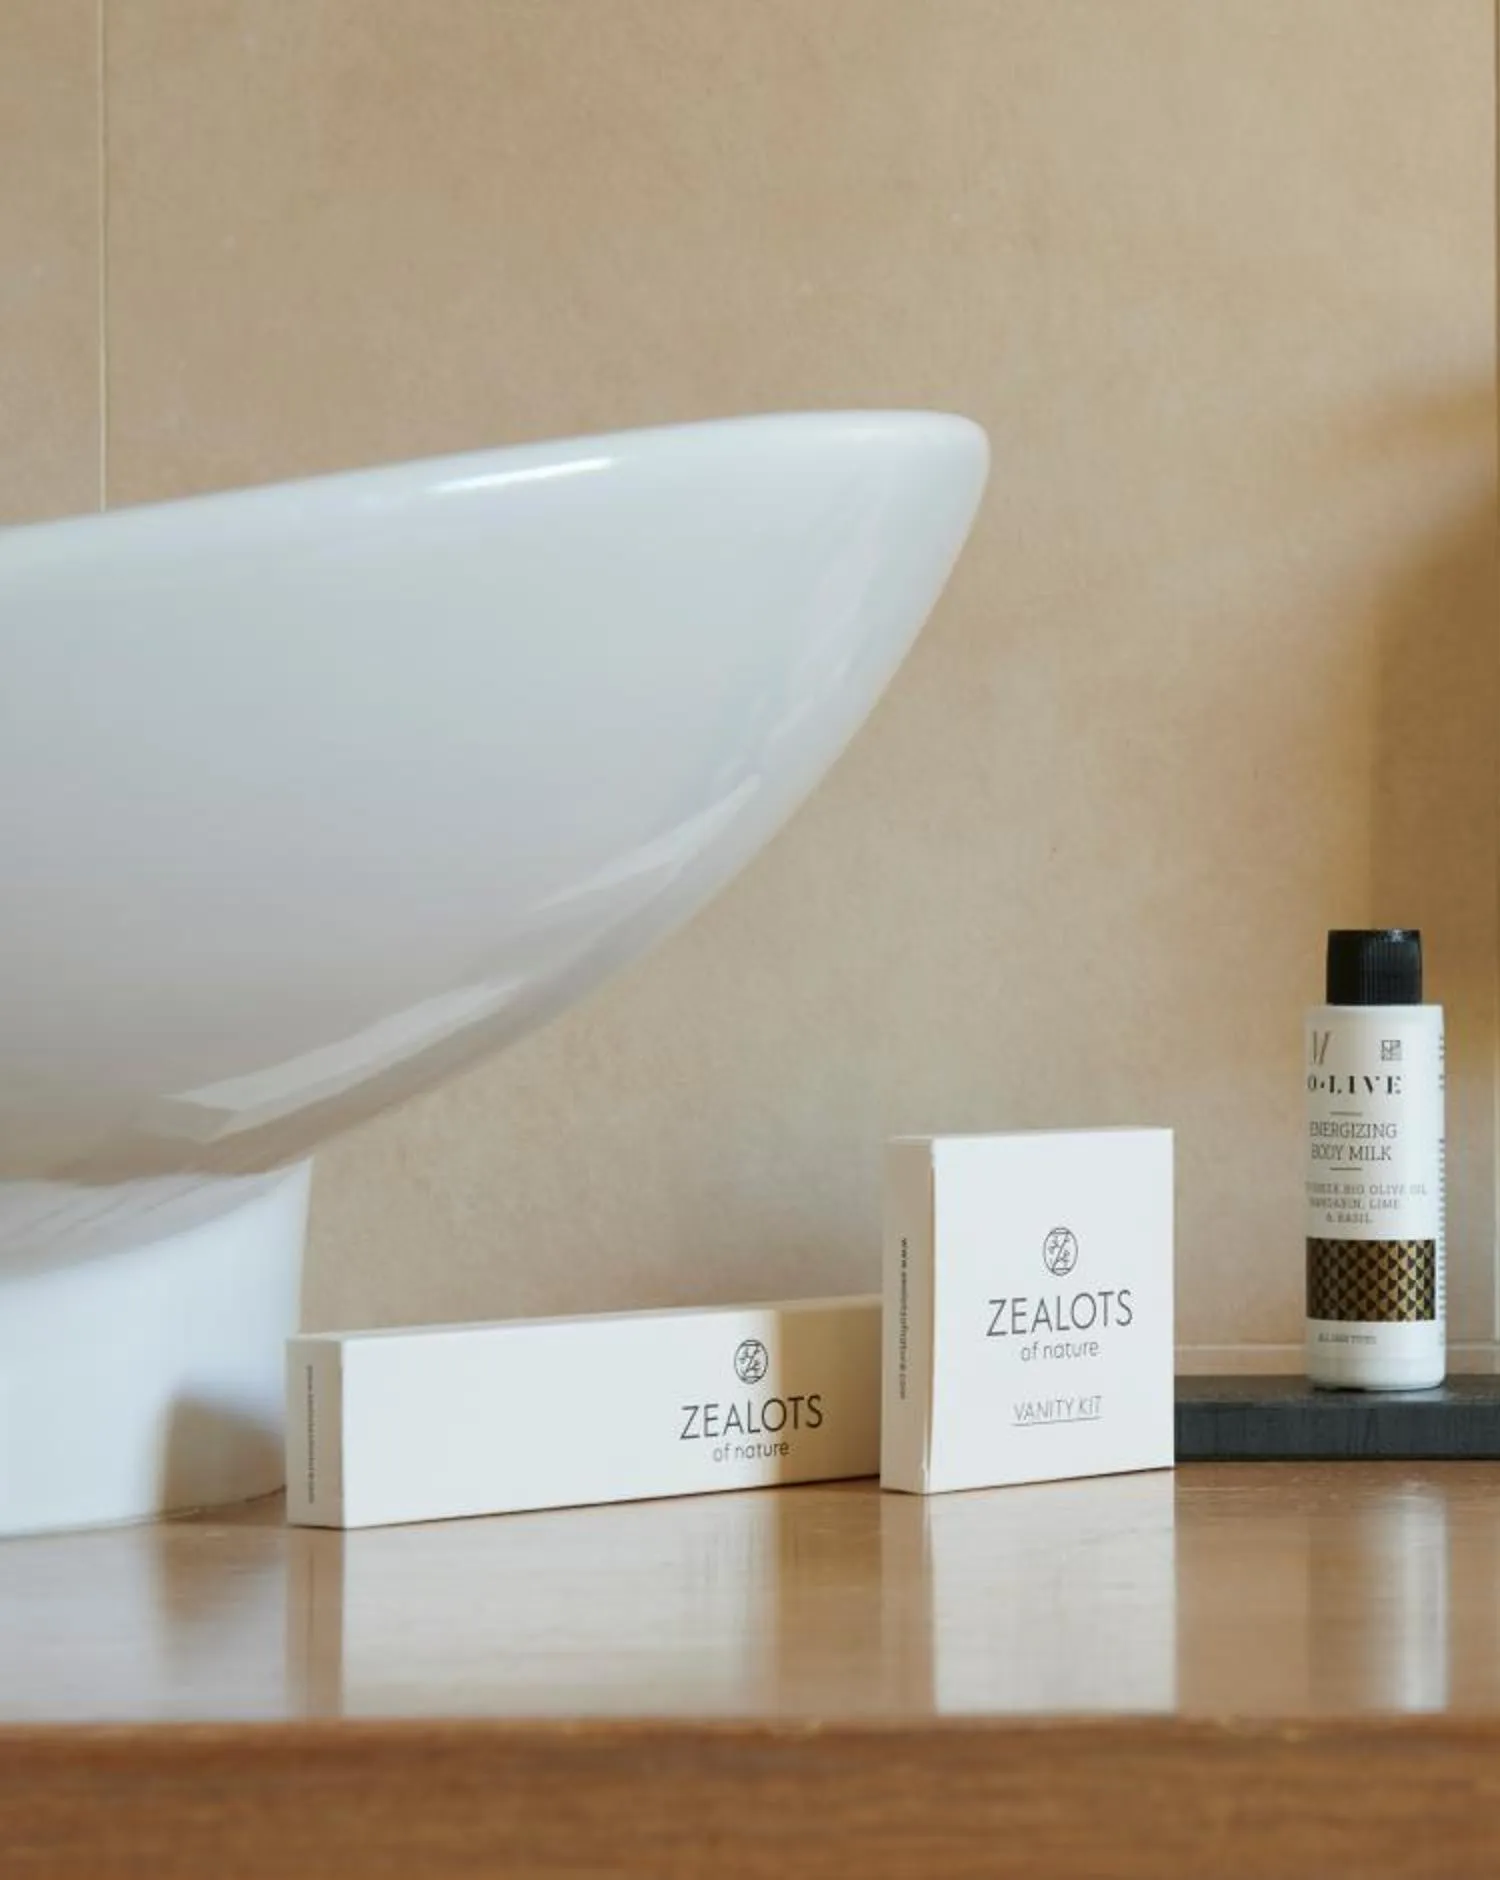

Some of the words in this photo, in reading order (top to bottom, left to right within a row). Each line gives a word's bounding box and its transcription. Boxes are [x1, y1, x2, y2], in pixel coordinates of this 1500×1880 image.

[1309, 1121, 1398, 1139] ENERGIZING
[1311, 1145, 1344, 1161] BODY
[1349, 1145, 1393, 1161] MILK
[986, 1288, 1133, 1337] ZEALOTS
[1020, 1341, 1039, 1362] of
[1042, 1340, 1100, 1360] nature
[679, 1394, 823, 1441] ZEALOTS
[1013, 1398, 1075, 1421] VANITY
[1079, 1394, 1103, 1416] KIT
[712, 1443, 732, 1462] of
[735, 1440, 790, 1460] nature
